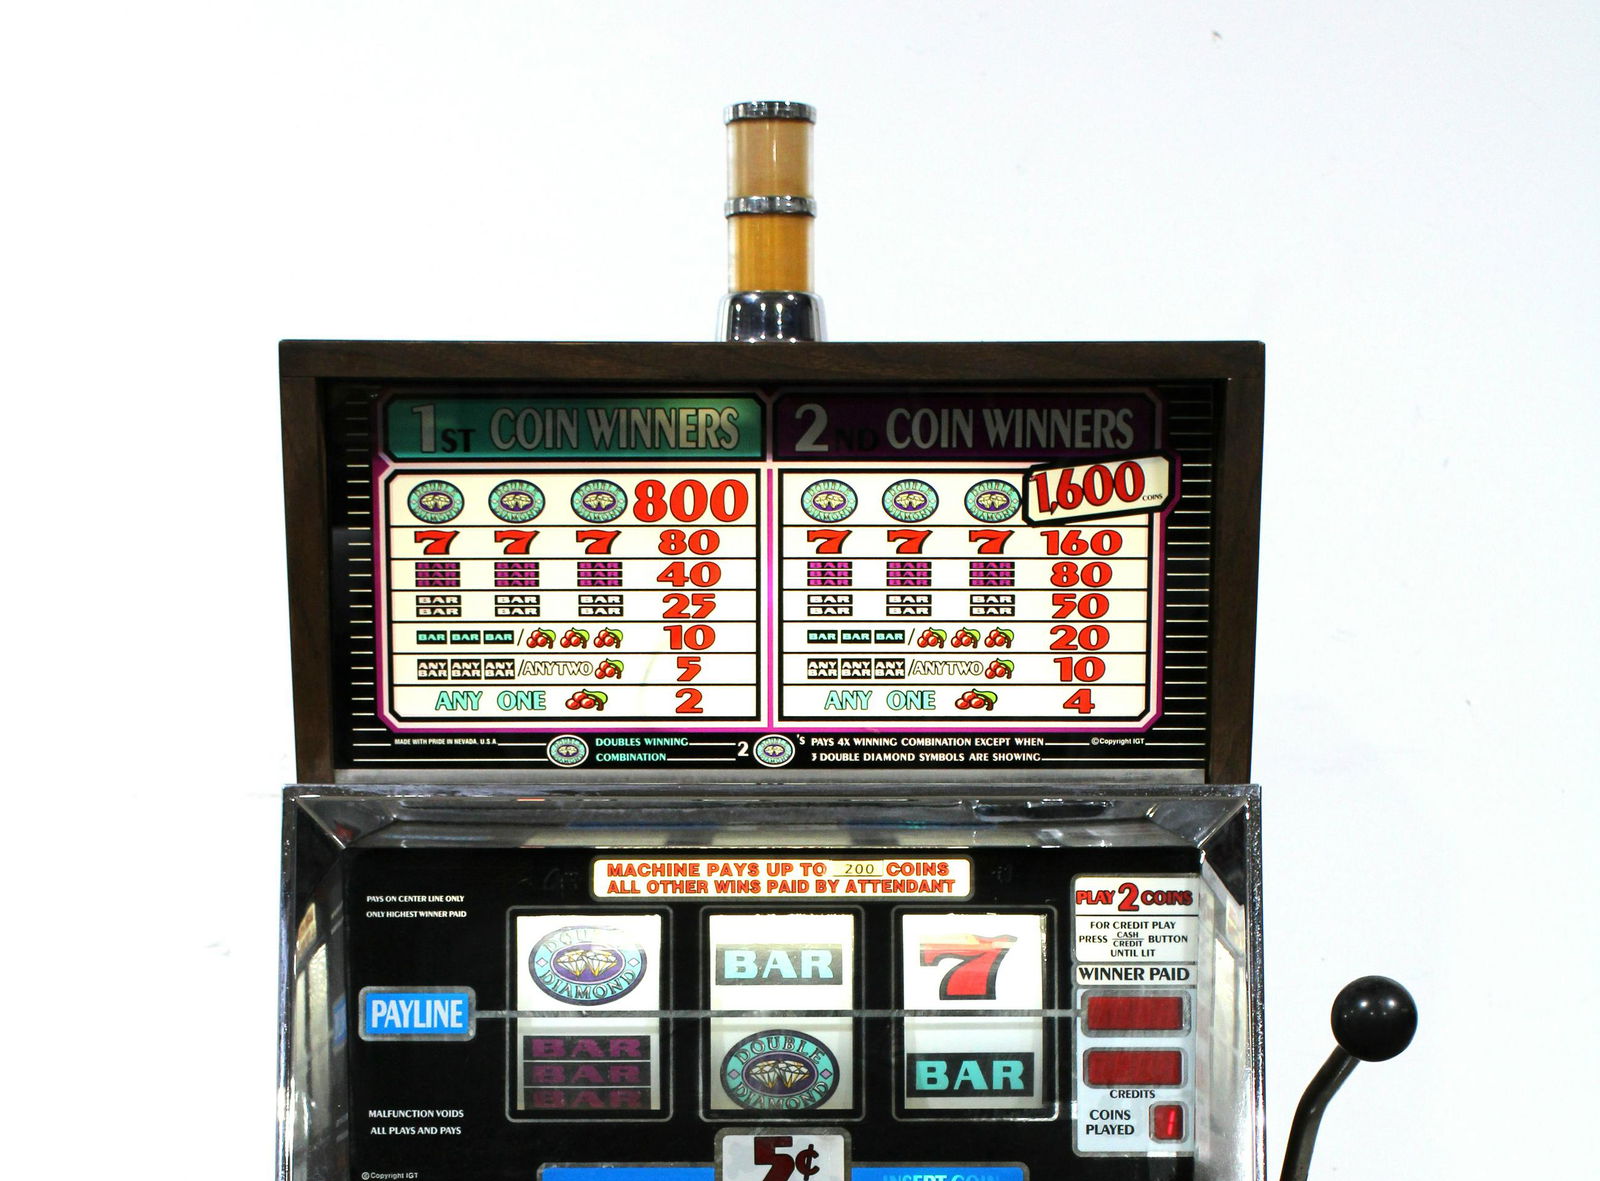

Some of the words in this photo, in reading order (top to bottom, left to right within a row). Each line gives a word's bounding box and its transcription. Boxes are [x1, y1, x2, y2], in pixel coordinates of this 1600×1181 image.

[489, 407, 578, 451] COIN
[586, 407, 740, 451] WINNERS
[886, 407, 973, 450] COIN
[983, 407, 1134, 450] WINNERS
[1031, 461, 1145, 515] 1,600
[633, 479, 748, 523] 800
[414, 530, 460, 555] 7
[494, 530, 540, 555] 7
[576, 530, 622, 555] 7
[658, 529, 720, 555] 80
[807, 530, 853, 555] 7
[887, 530, 933, 555] 7
[969, 530, 1015, 555] 7
[1040, 529, 1124, 556] 160
[657, 561, 721, 587] 40
[1050, 561, 1112, 587] 80
[419, 596, 459, 604] BAR
[497, 596, 537, 604] BAR
[580, 596, 620, 604] BAR
[662, 593, 716, 619] 25
[810, 596, 850, 604] BAR
[889, 596, 929, 604] BAR
[972, 596, 1012, 604] BAR
[1051, 593, 1109, 619] 50
[418, 633, 446, 641] BAR
[452, 633, 480, 641] BAR
[485, 633, 513, 641] BAR
[663, 625, 715, 650] 10
[809, 632, 837, 640] BAR
[842, 632, 870, 640] BAR
[876, 632, 904, 640] BAR
[1049, 625, 1109, 650] 20
[418, 661, 447, 669] ANY
[452, 661, 480, 669] ANY
[485, 661, 514, 669] ANY
[418, 670, 447, 678] BAR
[452, 670, 480, 678] BAR
[485, 670, 514, 678] BAR
[676, 657, 701, 681] 5
[808, 661, 837, 669] ANY
[842, 661, 870, 669] ANY
[875, 661, 904, 669] ANY
[808, 669, 837, 677] BAR
[842, 669, 870, 677] BAR
[875, 669, 904, 677] BAR
[1053, 656, 1106, 682] 10
[435, 690, 482, 711] ANY
[496, 690, 546, 711] ONE
[675, 688, 703, 713] 2
[824, 690, 872, 710] ANY
[886, 690, 936, 710] ONE
[1062, 688, 1095, 714] 4
[595, 738, 641, 746] DOUBLES
[644, 738, 689, 746] WINNING
[738, 741, 749, 757] 2
[811, 738, 834, 746] PAYS
[837, 738, 850, 746] 4X
[853, 738, 898, 746] WINNING
[901, 738, 972, 746] COMBINATION
[975, 738, 1011, 746] EXCEPT
[1014, 738, 1044, 746] WHEN
[596, 753, 667, 762] COMBINATION
[819, 753, 860, 762] DOUBLE
[863, 753, 916, 762] DIAMOND
[919, 753, 965, 762] SYMBOLS
[968, 753, 990, 762] ARE
[992, 753, 1041, 762] SHOWING
[608, 862, 700, 878] MACHINE
[706, 862, 759, 878] PAYS
[766, 862, 793, 878] UP
[800, 862, 827, 878] TO
[844, 863, 875, 876] 200
[886, 862, 950, 878] COINS
[608, 880, 641, 894] ALL
[646, 880, 708, 894] OTHER
[714, 880, 762, 894] WINS
[766, 880, 810, 894] PAID
[815, 880, 839, 894] BY
[845, 880, 955, 894] ATTENDANT
[1076, 890, 1116, 905] PLAY
[1117, 882, 1140, 912] 2
[1140, 890, 1193, 905] COINS
[366, 910, 385, 918] ONLY
[386, 910, 418, 918] HIGHEST
[418, 910, 448, 918] WINNER
[448, 910, 467, 918] PAID
[1090, 921, 1110, 930] FOR
[1112, 921, 1150, 930] CREDIT
[1152, 921, 1176, 930] PLAY
[1079, 935, 1108, 944] PRESS
[1148, 934, 1188, 944] BUTTON
[1113, 940, 1143, 948] CREDIT
[1110, 949, 1138, 958] UNTIL
[1140, 949, 1156, 958] LIT
[724, 950, 833, 978] BAR
[920, 934, 1018, 1000] 7
[1079, 967, 1145, 981] WINNER
[1150, 967, 1190, 981] PAID
[540, 969, 636, 999] DIAMOND
[371, 999, 463, 1028] PAYLINE
[531, 1038, 641, 1058] BAR
[734, 1035, 826, 1065] DOUBLE
[531, 1065, 641, 1084] BAR
[915, 1060, 1025, 1090] BAR
[531, 1090, 641, 1109] BAR
[732, 1081, 829, 1109] DIAMOND
[1110, 1090, 1156, 1098] CREDITS
[368, 1110, 434, 1118] MALFUNCTION
[436, 1110, 464, 1118] VOIDS
[1090, 1109, 1131, 1120] COINS
[370, 1126, 386, 1135] ALL
[388, 1126, 416, 1135] PLAYS
[418, 1126, 438, 1135] AND
[440, 1126, 462, 1135] PAYS
[1086, 1124, 1134, 1136] PLAYED
